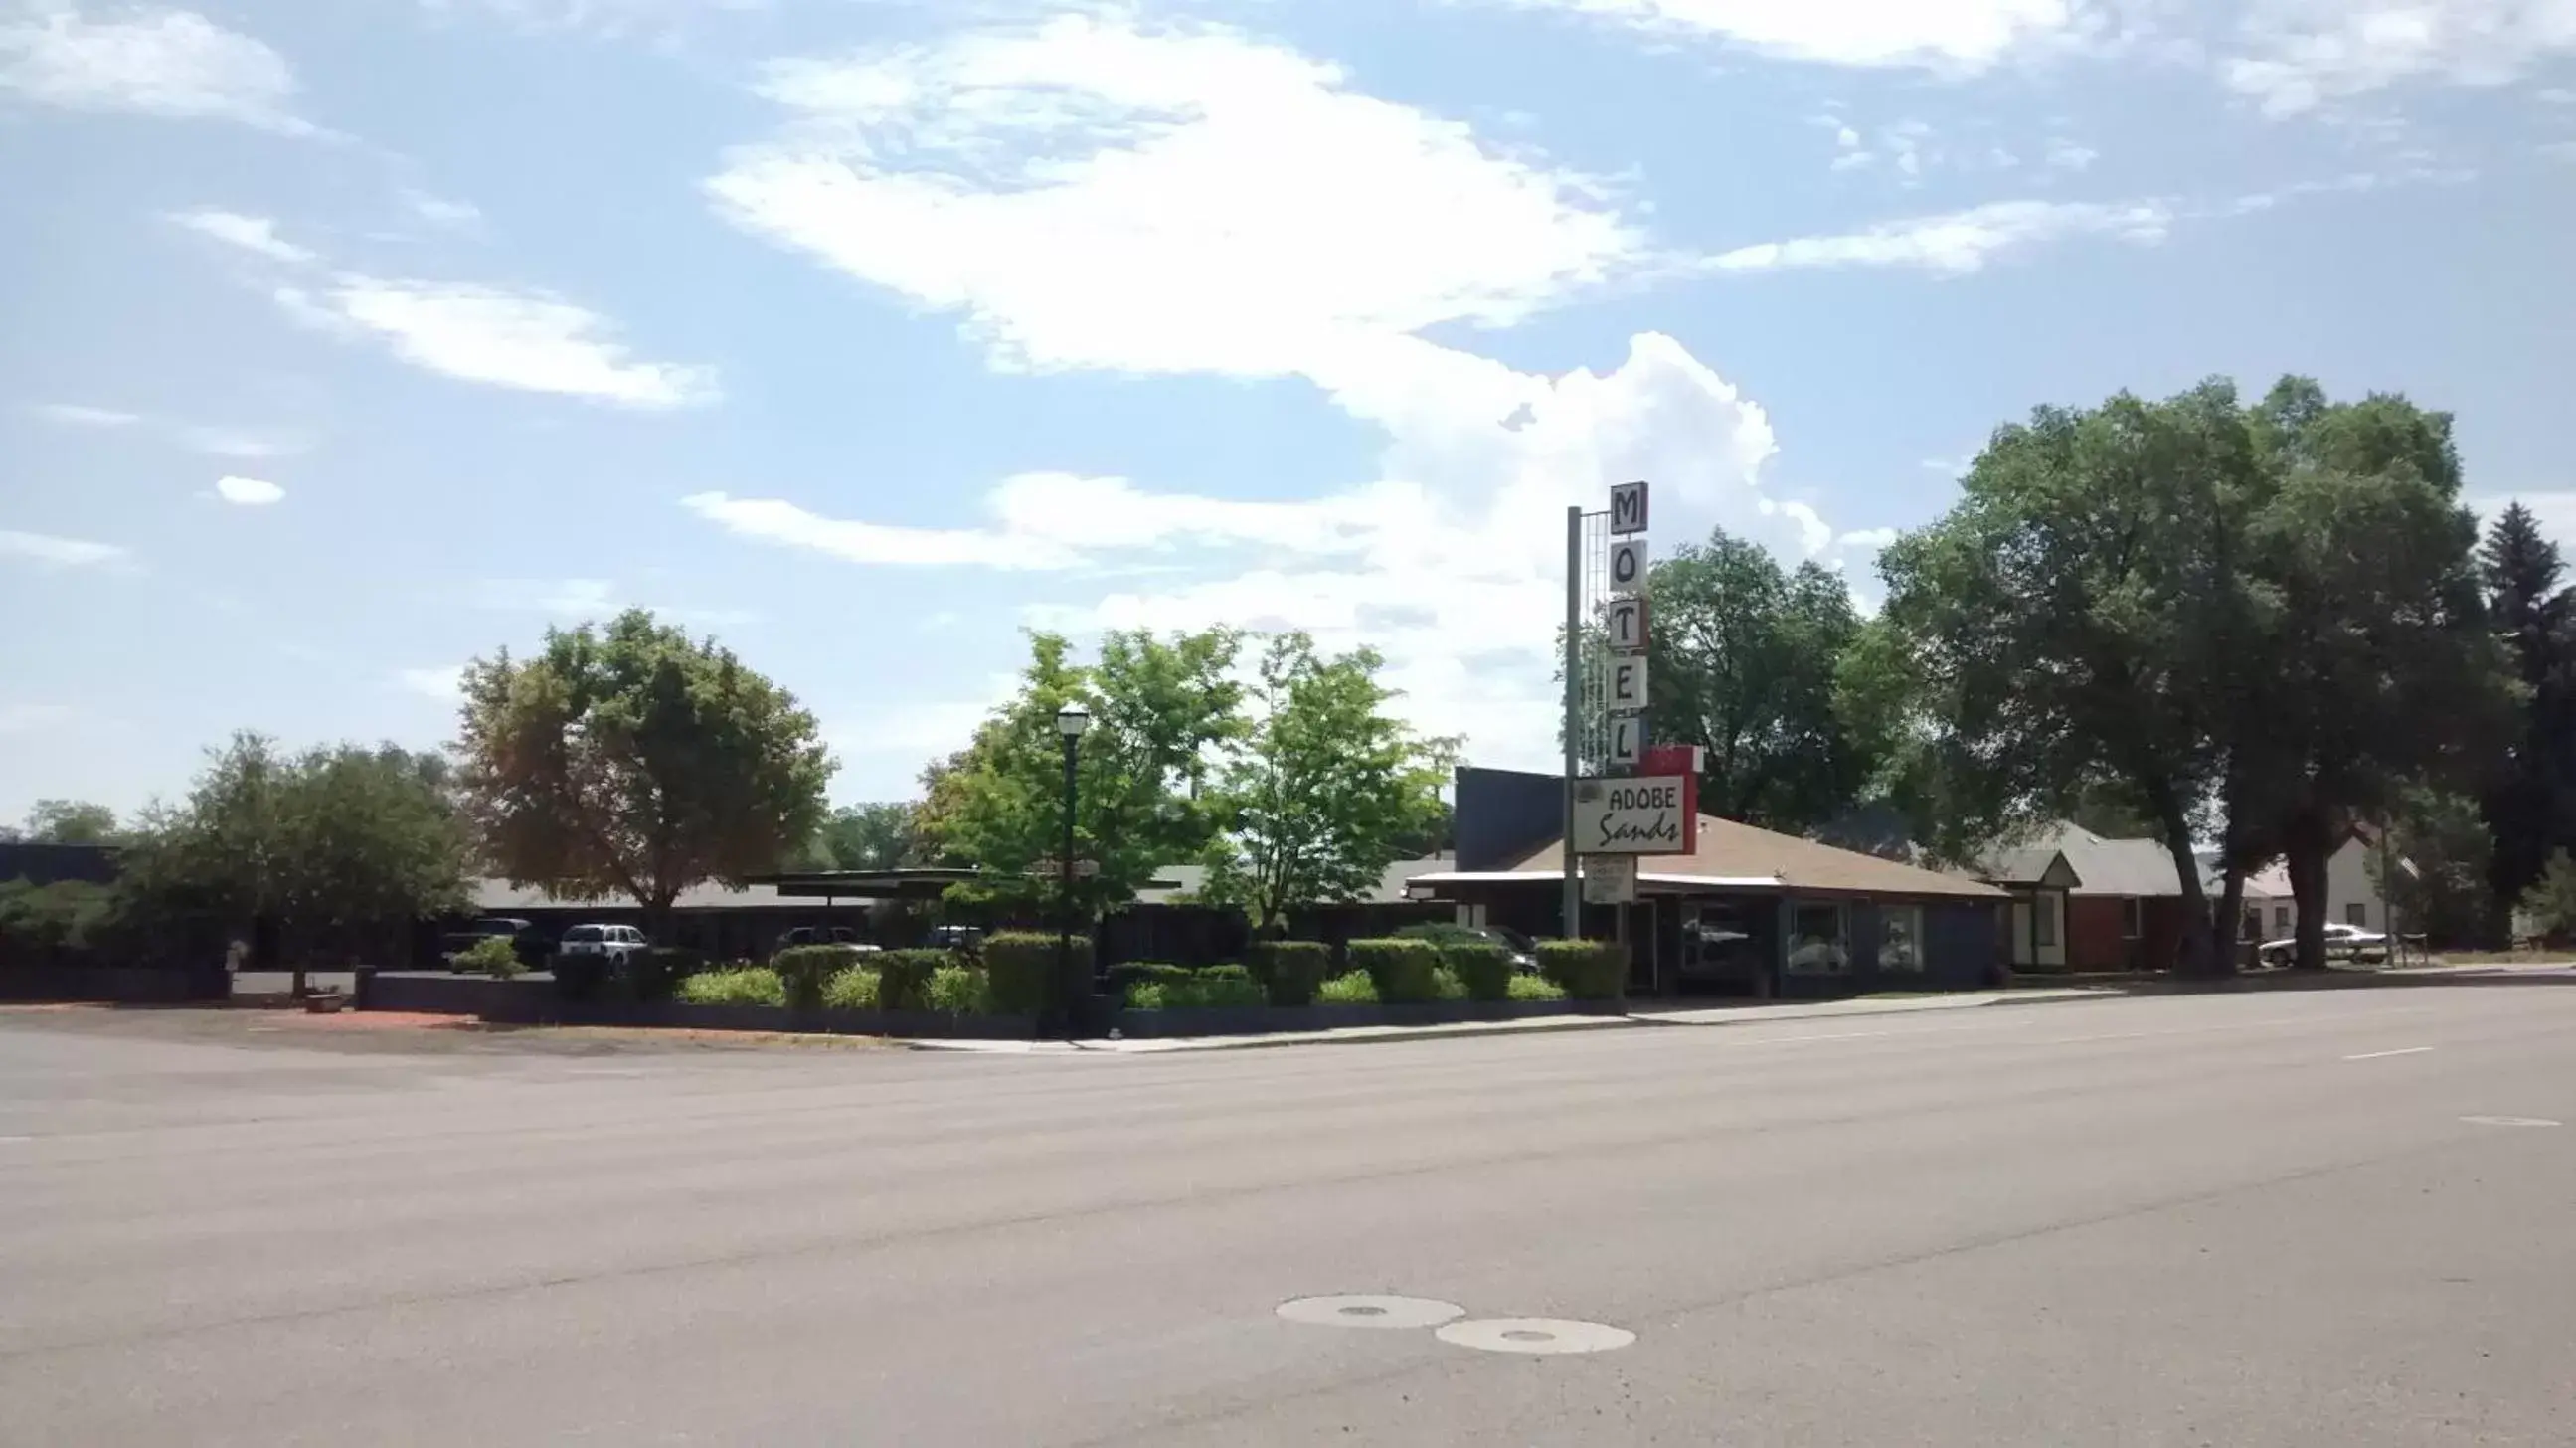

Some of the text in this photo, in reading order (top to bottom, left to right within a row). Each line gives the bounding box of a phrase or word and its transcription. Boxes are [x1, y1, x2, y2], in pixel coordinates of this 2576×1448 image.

[1614, 490, 1638, 759] MOTEL
[1609, 787, 1677, 810] ADOBE
[1599, 812, 1679, 847] Sands
